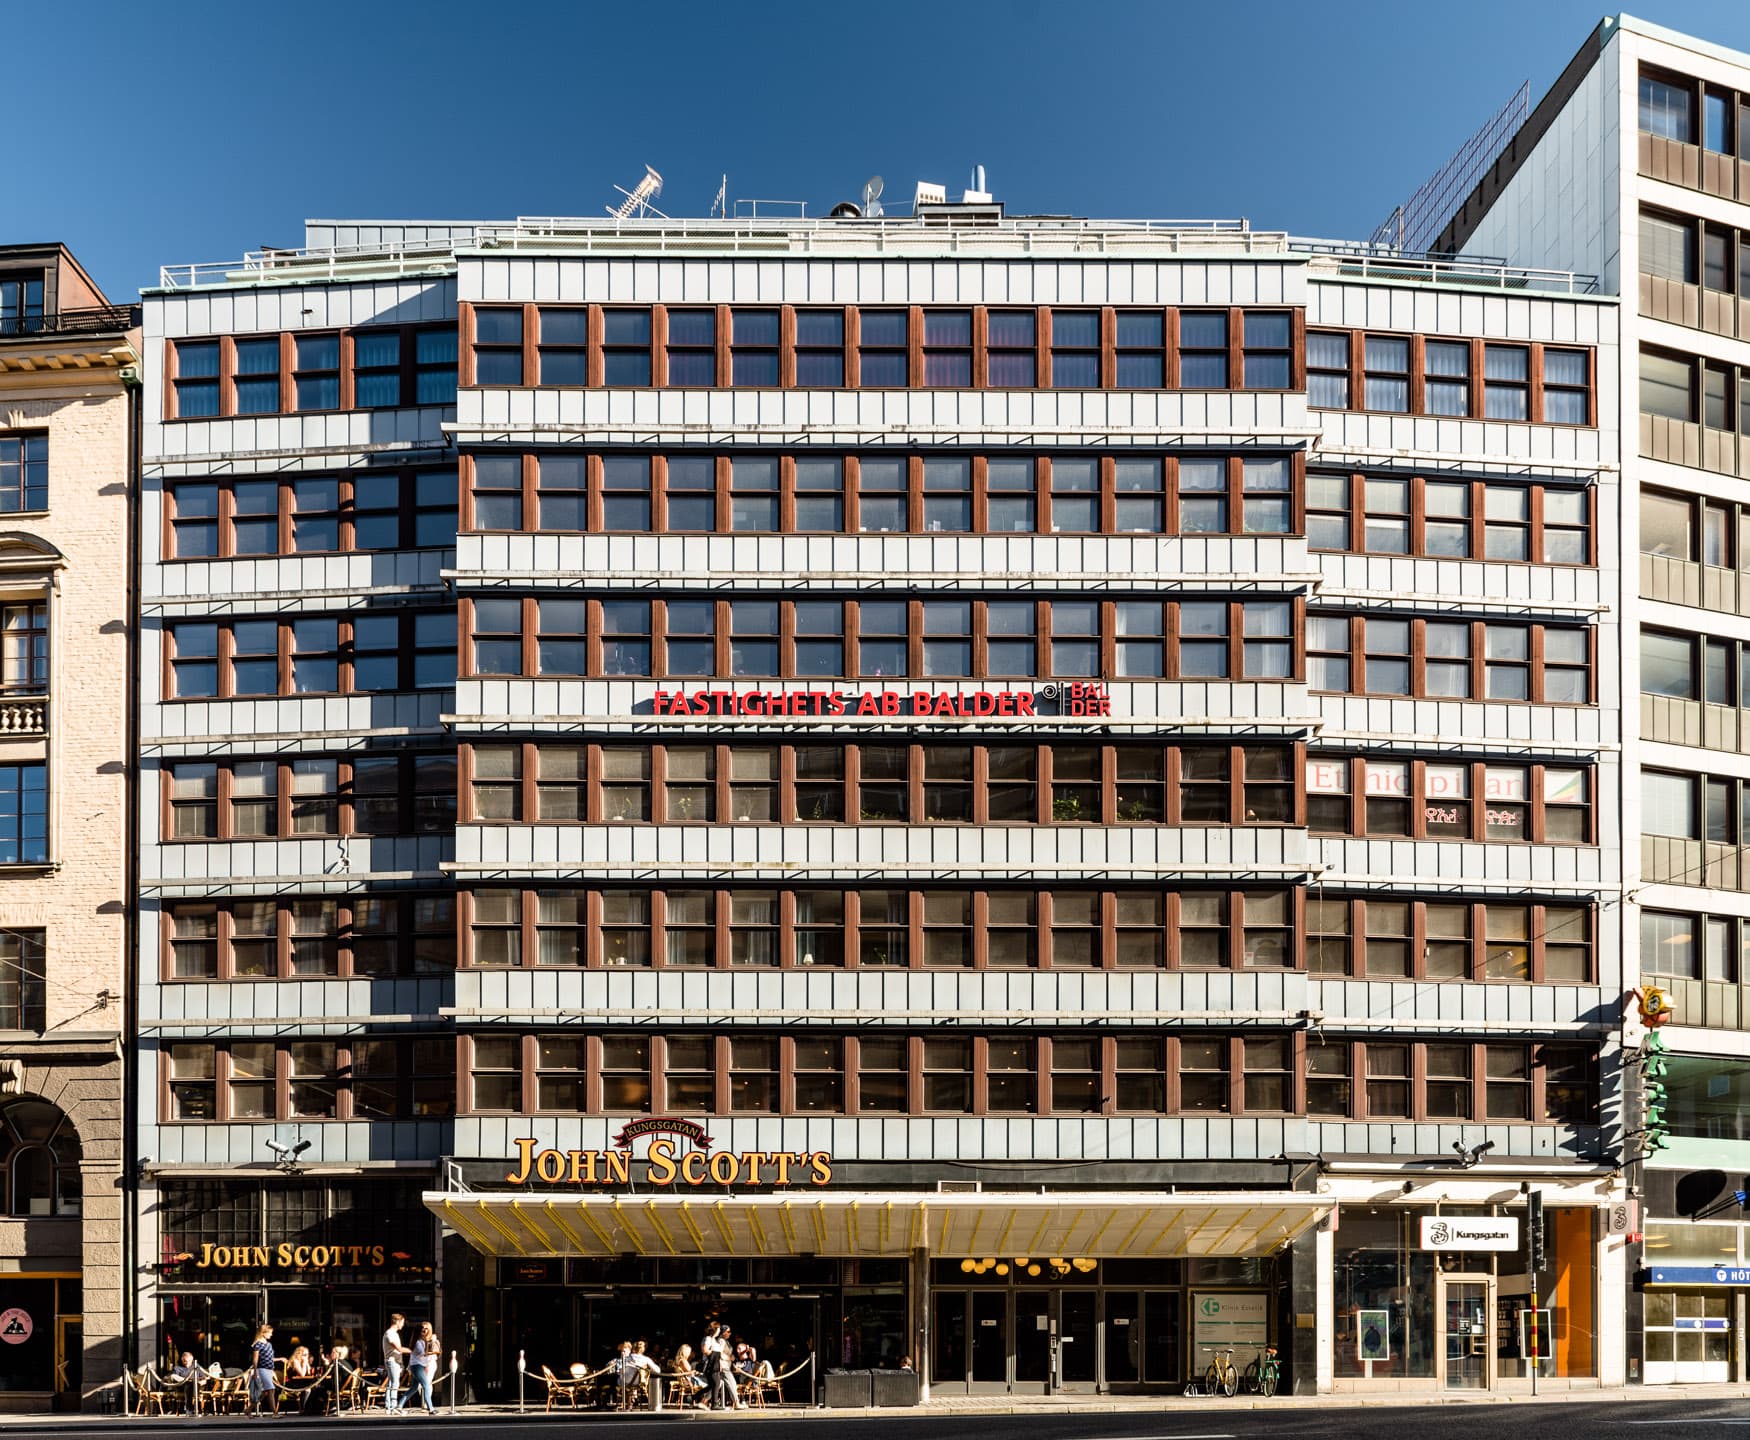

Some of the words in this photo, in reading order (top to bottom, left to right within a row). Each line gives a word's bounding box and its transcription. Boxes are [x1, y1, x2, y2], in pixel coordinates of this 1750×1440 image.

[1071, 681, 1110, 699] BAL
[653, 690, 844, 717] FASTIGHETS
[857, 691, 900, 717] AB
[914, 691, 1035, 717] BALDER
[1071, 699, 1112, 717] DER
[626, 1120, 699, 1137] KUNGSGATAN
[506, 1138, 633, 1186] JOHN
[647, 1139, 833, 1186] SCOTT'S
[1456, 1230, 1509, 1241] Kungsgatan
[196, 1242, 271, 1268] JOHN
[277, 1242, 385, 1268] SCOTT'S
